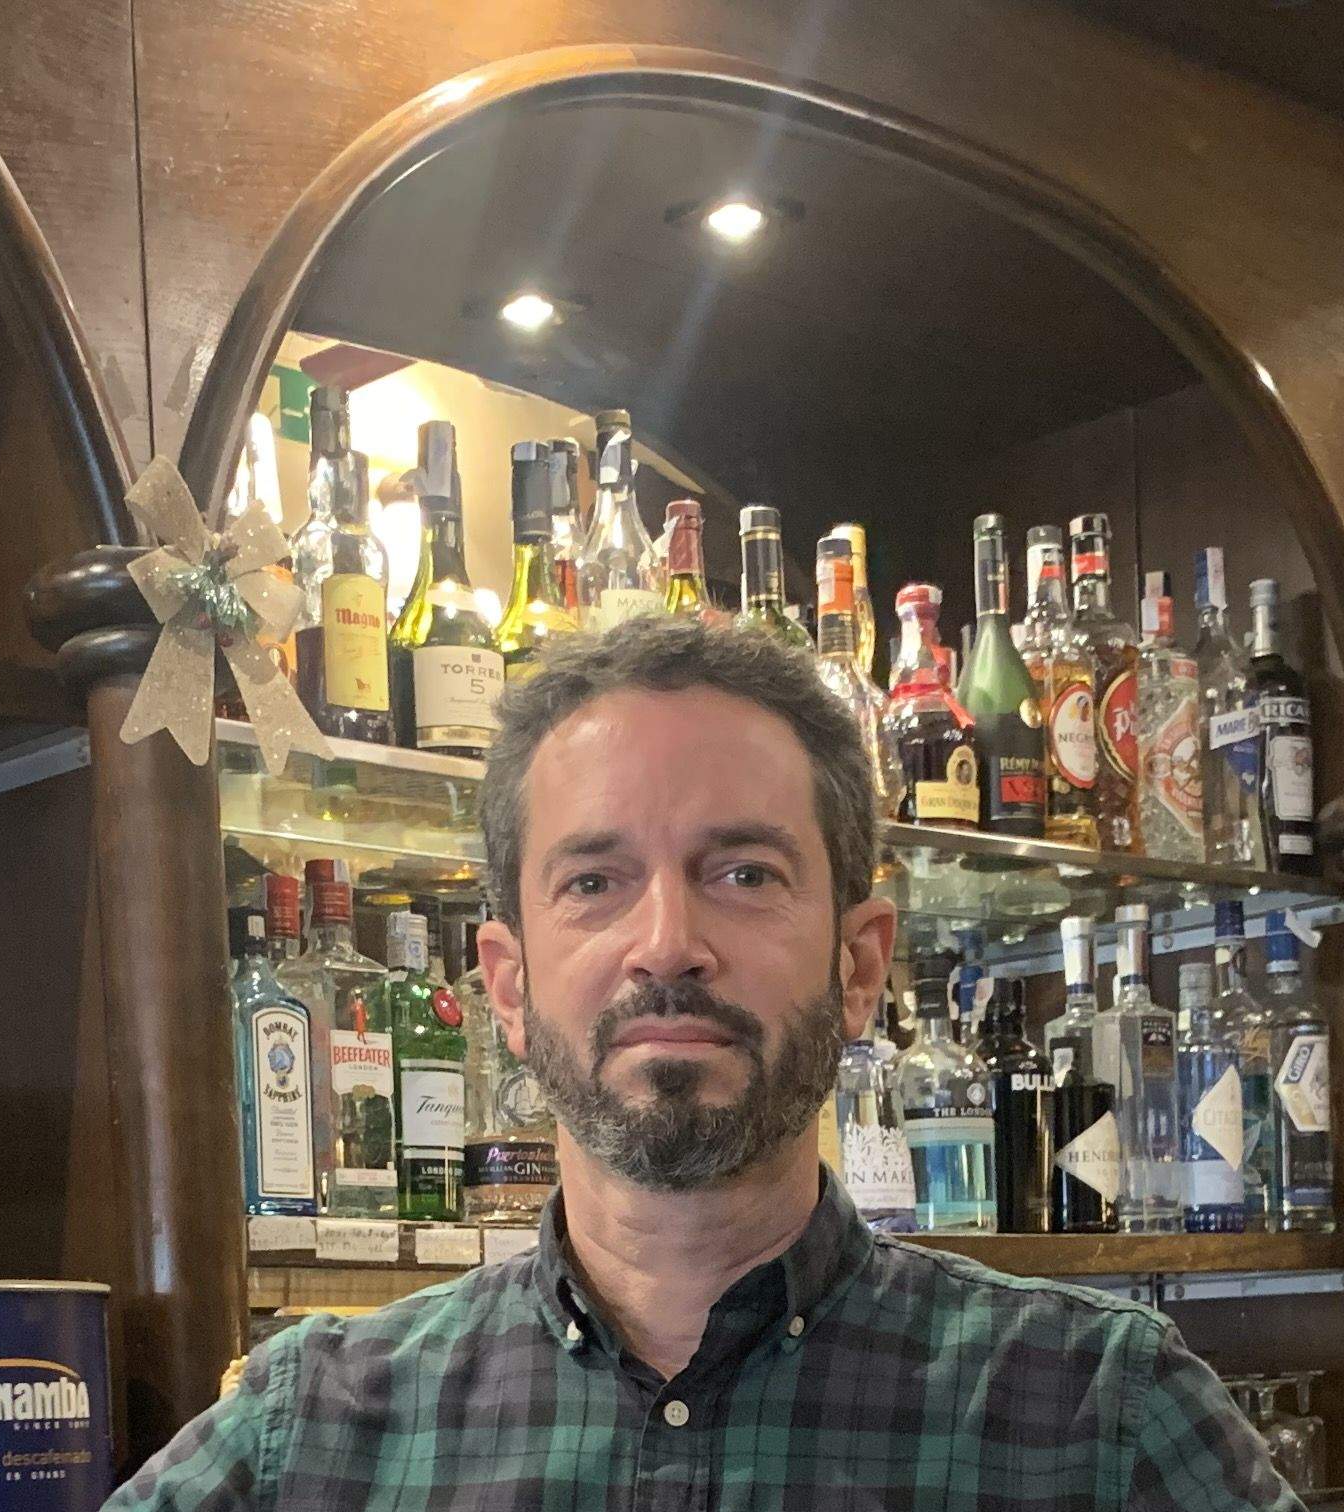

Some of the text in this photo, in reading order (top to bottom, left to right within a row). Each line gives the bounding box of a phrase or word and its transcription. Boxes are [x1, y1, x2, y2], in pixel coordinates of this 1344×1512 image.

[470, 679, 485, 695] 5
[333, 1046, 391, 1067] BEEFEATER
[514, 1161, 541, 1175] GIN
